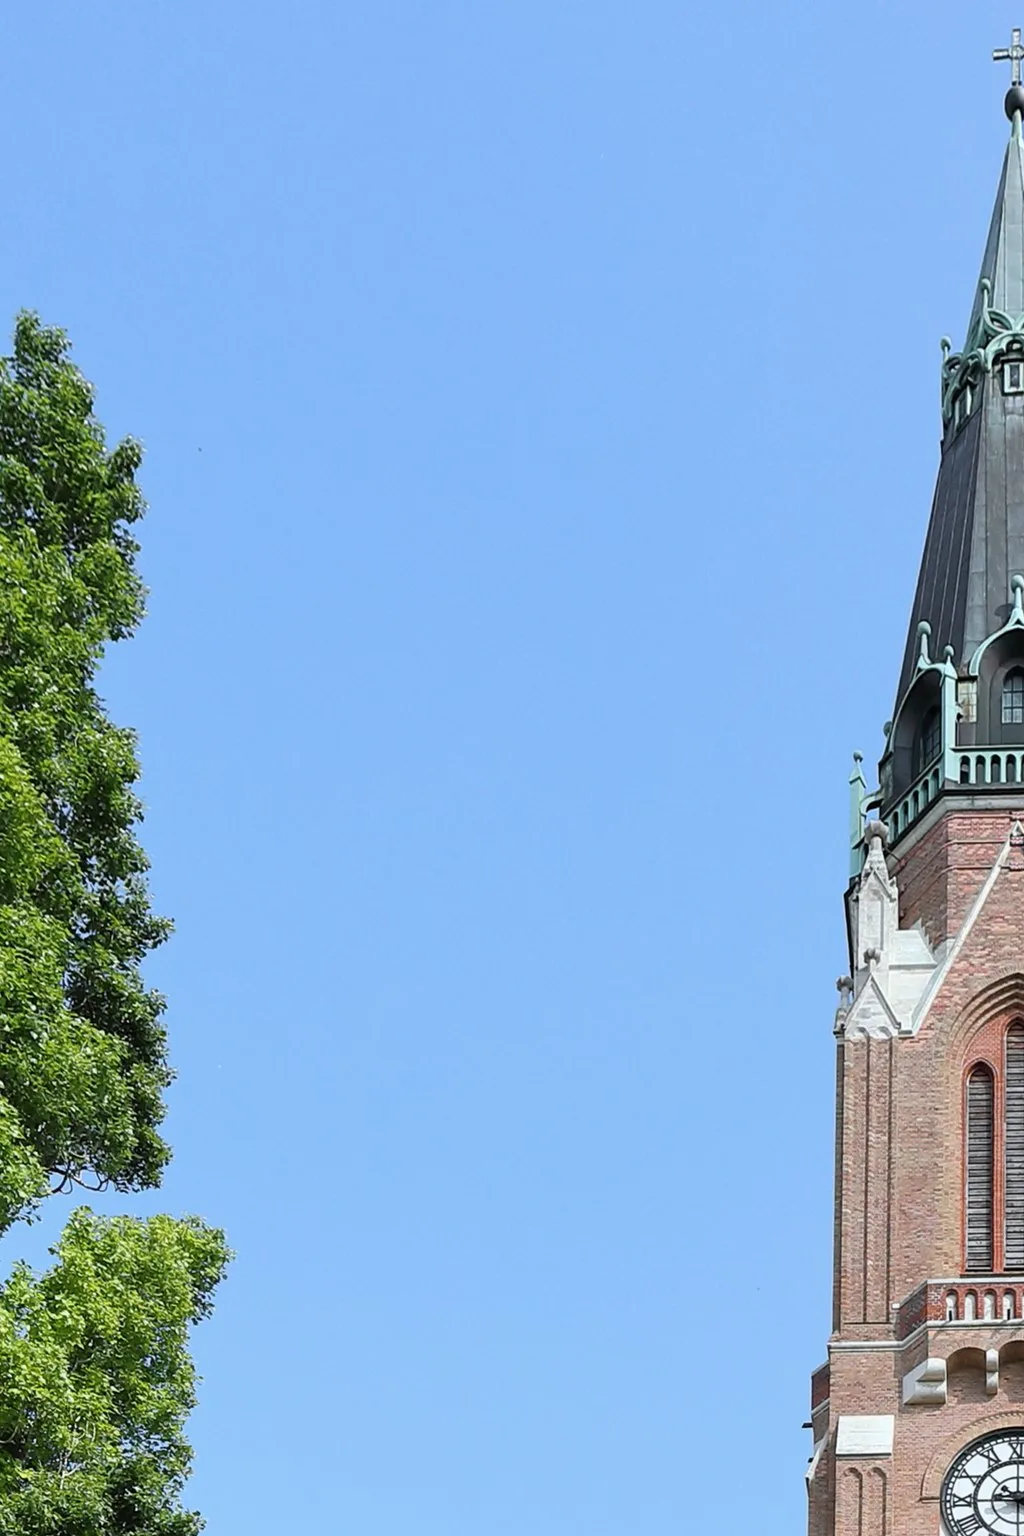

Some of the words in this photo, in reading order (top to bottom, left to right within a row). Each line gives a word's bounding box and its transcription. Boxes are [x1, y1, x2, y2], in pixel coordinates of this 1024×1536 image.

[978, 1448, 1001, 1468] XI
[958, 1468, 981, 1486] X
[953, 1493, 972, 1508] IX
